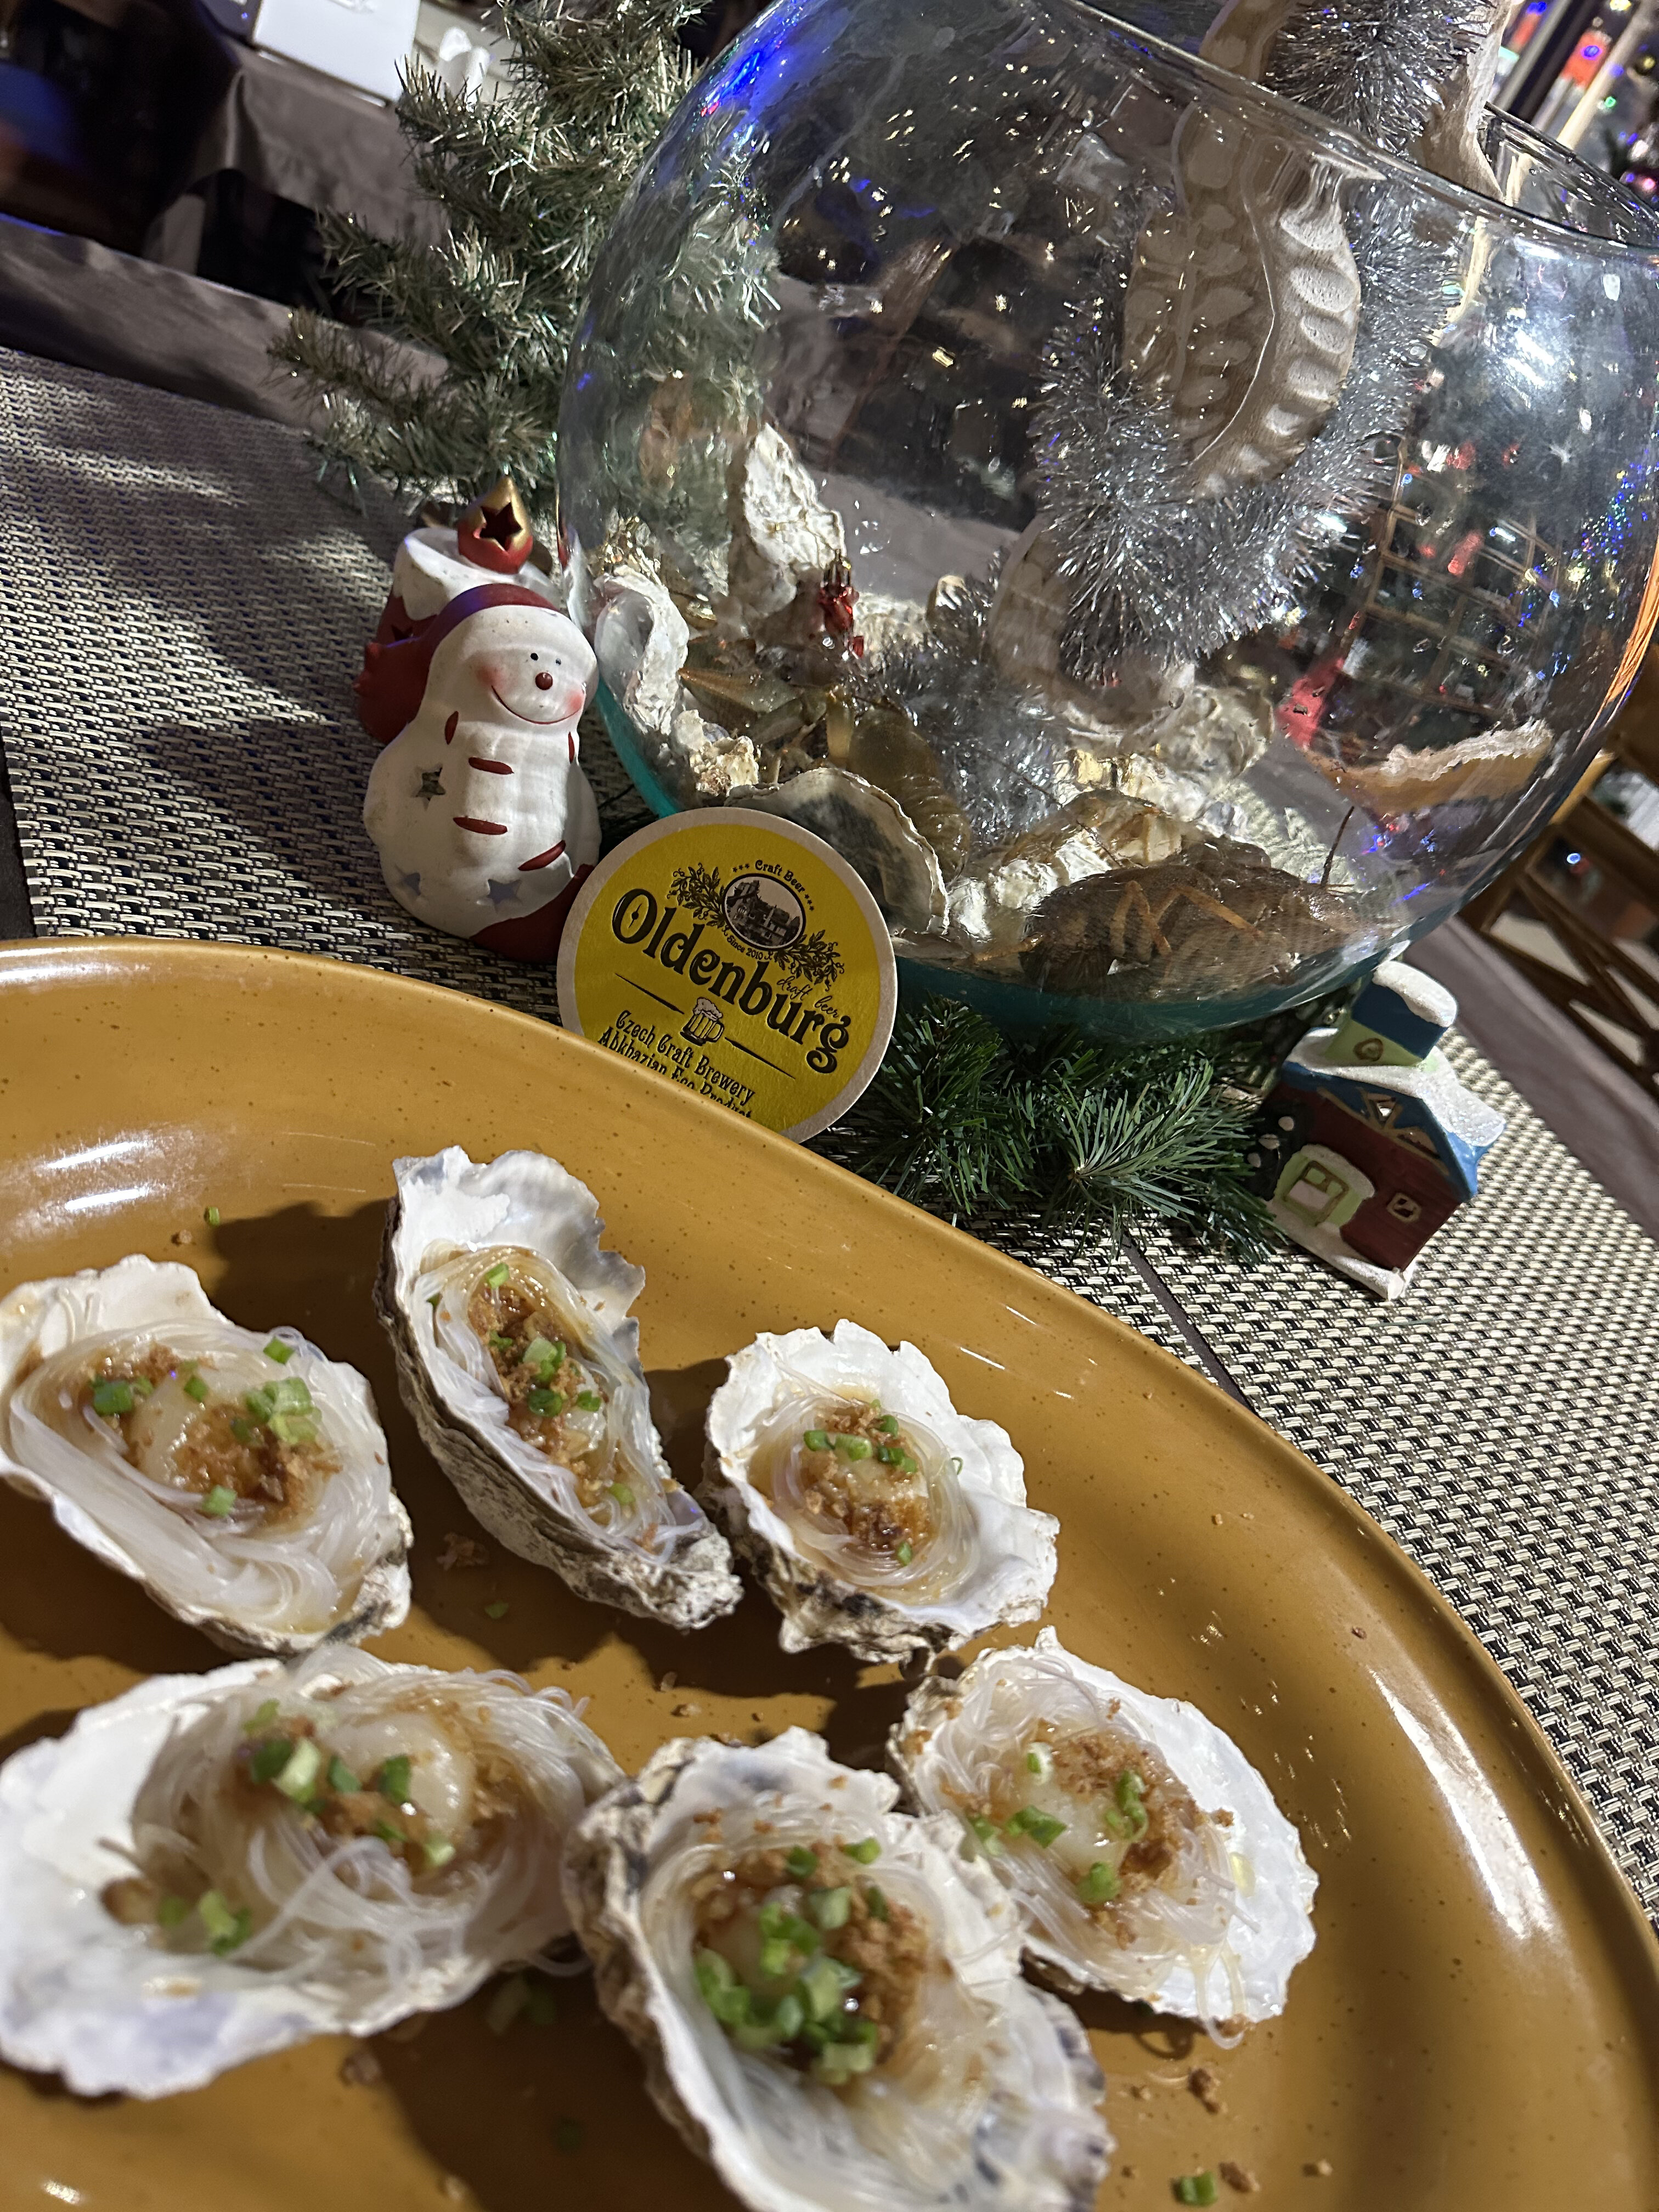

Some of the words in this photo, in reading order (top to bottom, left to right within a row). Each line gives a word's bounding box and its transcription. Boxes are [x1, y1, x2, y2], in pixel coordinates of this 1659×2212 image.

[755, 860, 782, 876] Craft
[783, 870, 805, 894] Beer
[727, 935, 745, 952] Since
[746, 948, 763, 960] 2010
[611, 888, 851, 1074] Oldenburg
[777, 975, 812, 1001] draft
[814, 995, 838, 1018] beer
[597, 1026, 667, 1075] Abkhazian
[616, 1010, 656, 1048] Czech
[657, 1034, 695, 1068] Craft
[694, 1054, 755, 1106] Brewery
